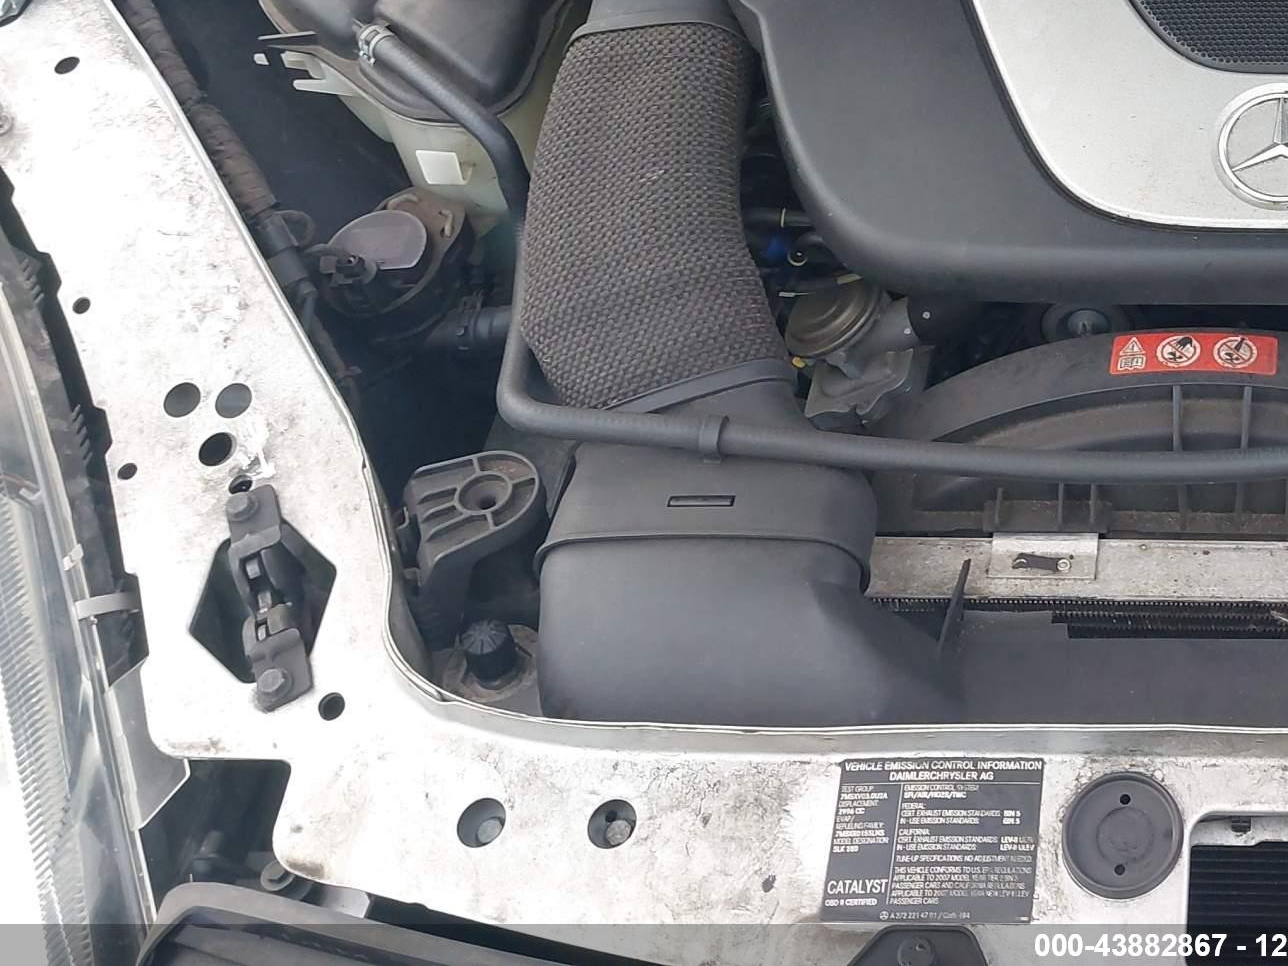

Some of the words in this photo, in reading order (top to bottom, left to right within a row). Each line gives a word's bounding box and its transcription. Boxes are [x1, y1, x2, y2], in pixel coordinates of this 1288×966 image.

[845, 762, 882, 771] VEHICLE
[885, 762, 929, 770] EMISSION
[932, 761, 976, 769] CONTROL
[978, 761, 1042, 770] INFORMATION
[890, 772, 978, 781] DAIMLERCHRYSLER
[827, 879, 888, 894] CATALYST
